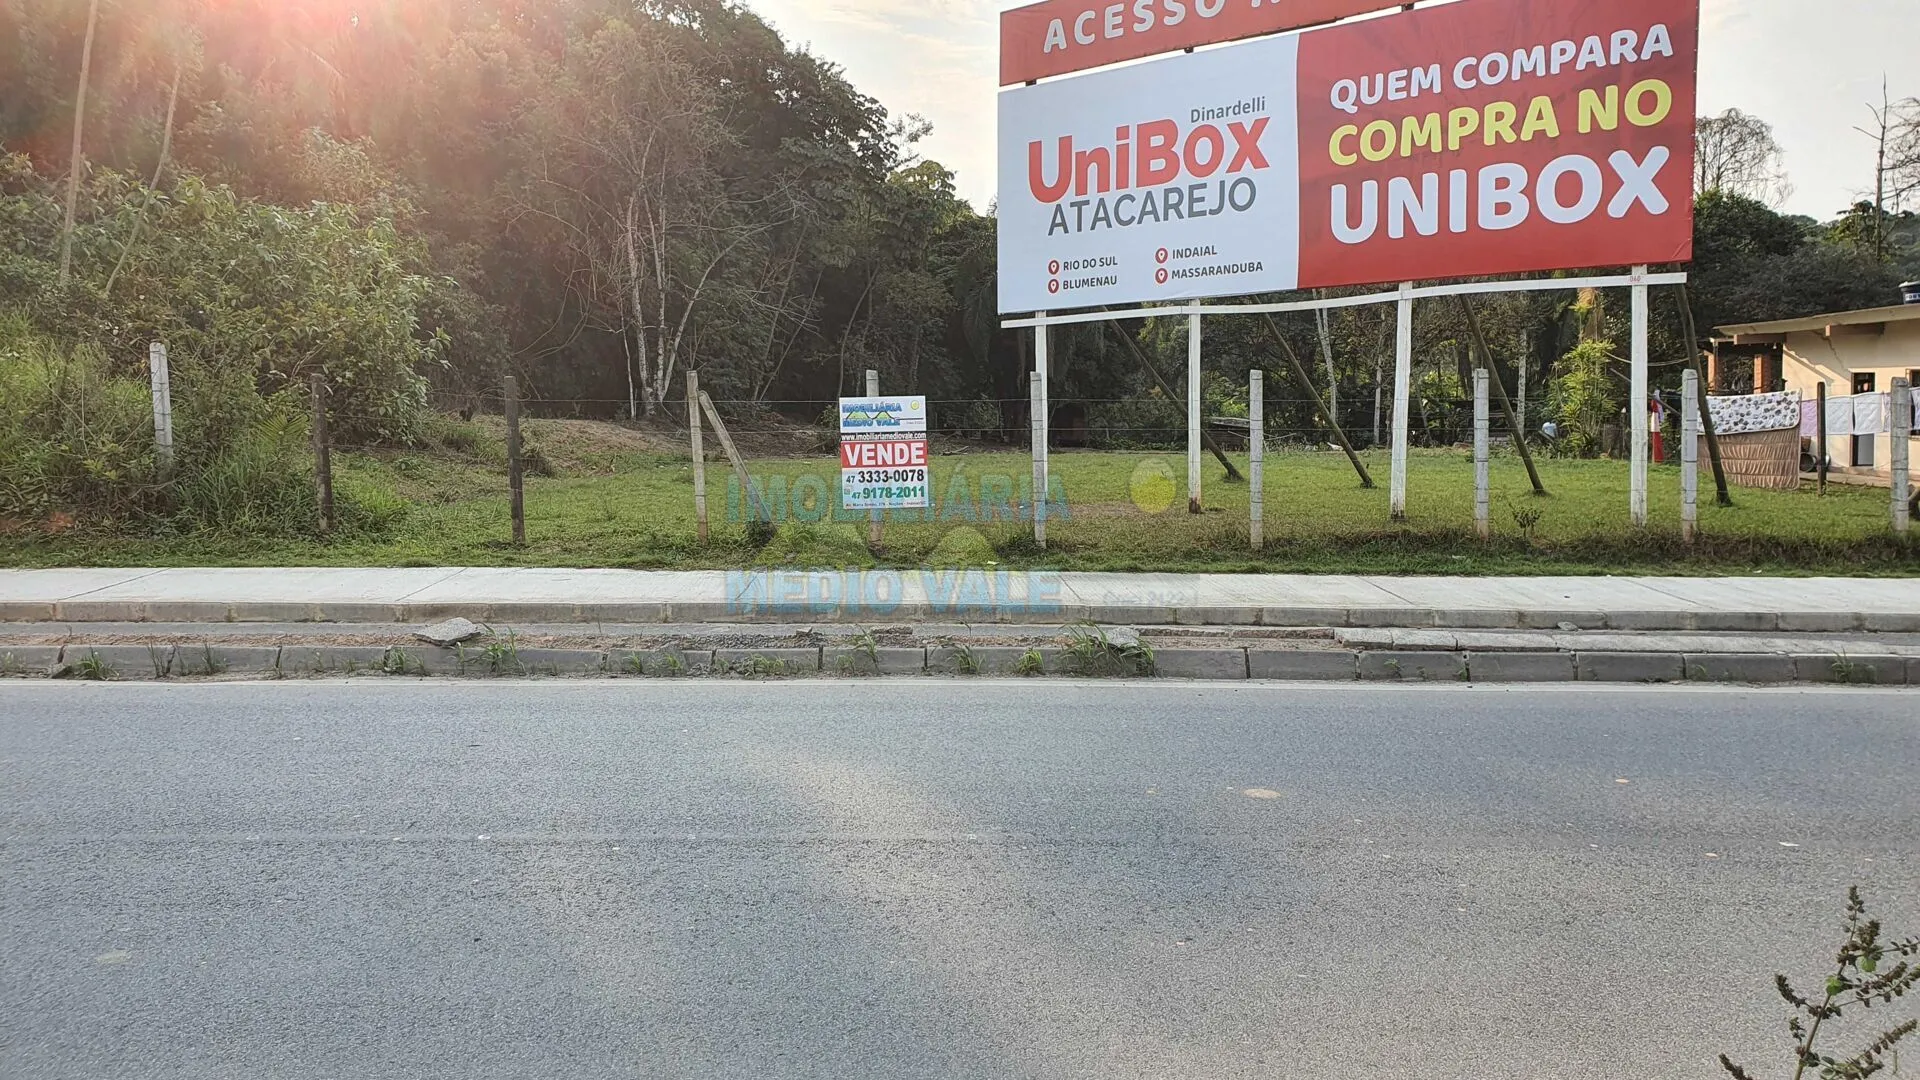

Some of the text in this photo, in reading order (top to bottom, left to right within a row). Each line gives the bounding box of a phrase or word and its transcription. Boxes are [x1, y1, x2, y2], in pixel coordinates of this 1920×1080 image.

[1042, 0, 1226, 54] ACESSO
[1330, 23, 1674, 114] QUEM COMPARA
[1190, 96, 1266, 124] Dinardelli
[1328, 78, 1673, 166] COMPRA NO
[1047, 176, 1257, 237] ATACAREJO
[1330, 145, 1670, 245] UNIBOX
[1063, 256, 1118, 271] RIO DO SUL
[1172, 245, 1217, 260] INDAIAL
[1172, 261, 1263, 280] MASSARANDUBA
[1063, 275, 1118, 290] BLUMENAU
[844, 443, 925, 466] VENDE
[846, 469, 925, 484] 47 3333-0078
[852, 485, 925, 500] 47 9178-2011
